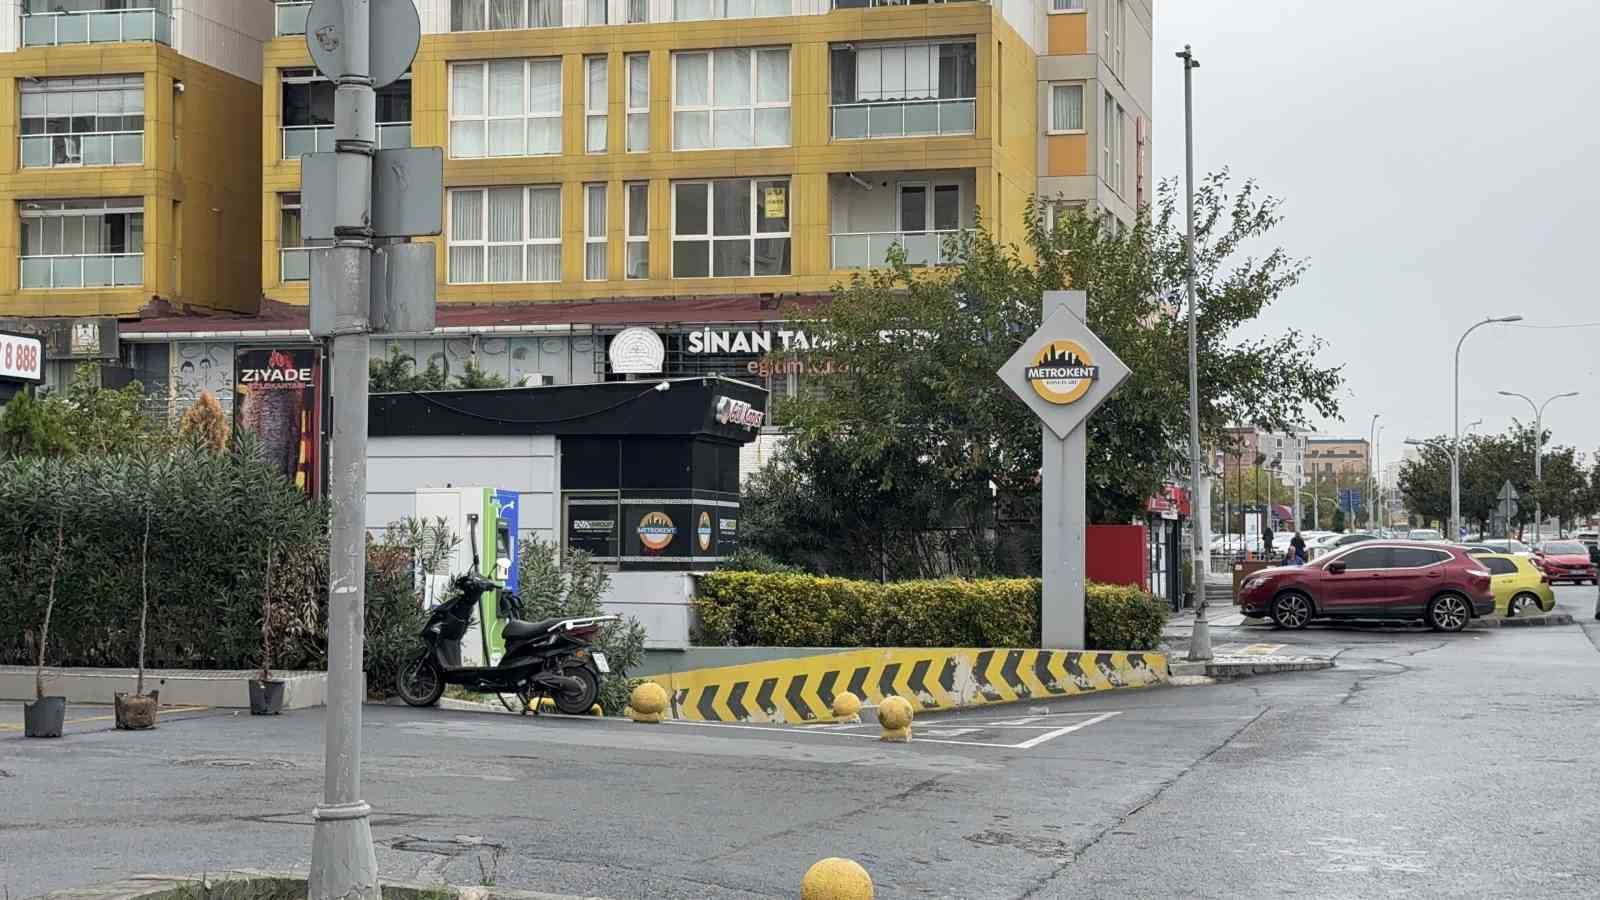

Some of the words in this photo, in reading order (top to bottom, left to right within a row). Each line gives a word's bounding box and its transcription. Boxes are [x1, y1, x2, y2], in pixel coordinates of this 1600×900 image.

[688, 327, 771, 353] SİNAN
[5, 342, 13, 370] 8
[16, 344, 37, 372] 888
[1028, 367, 1095, 378] METROKENT
